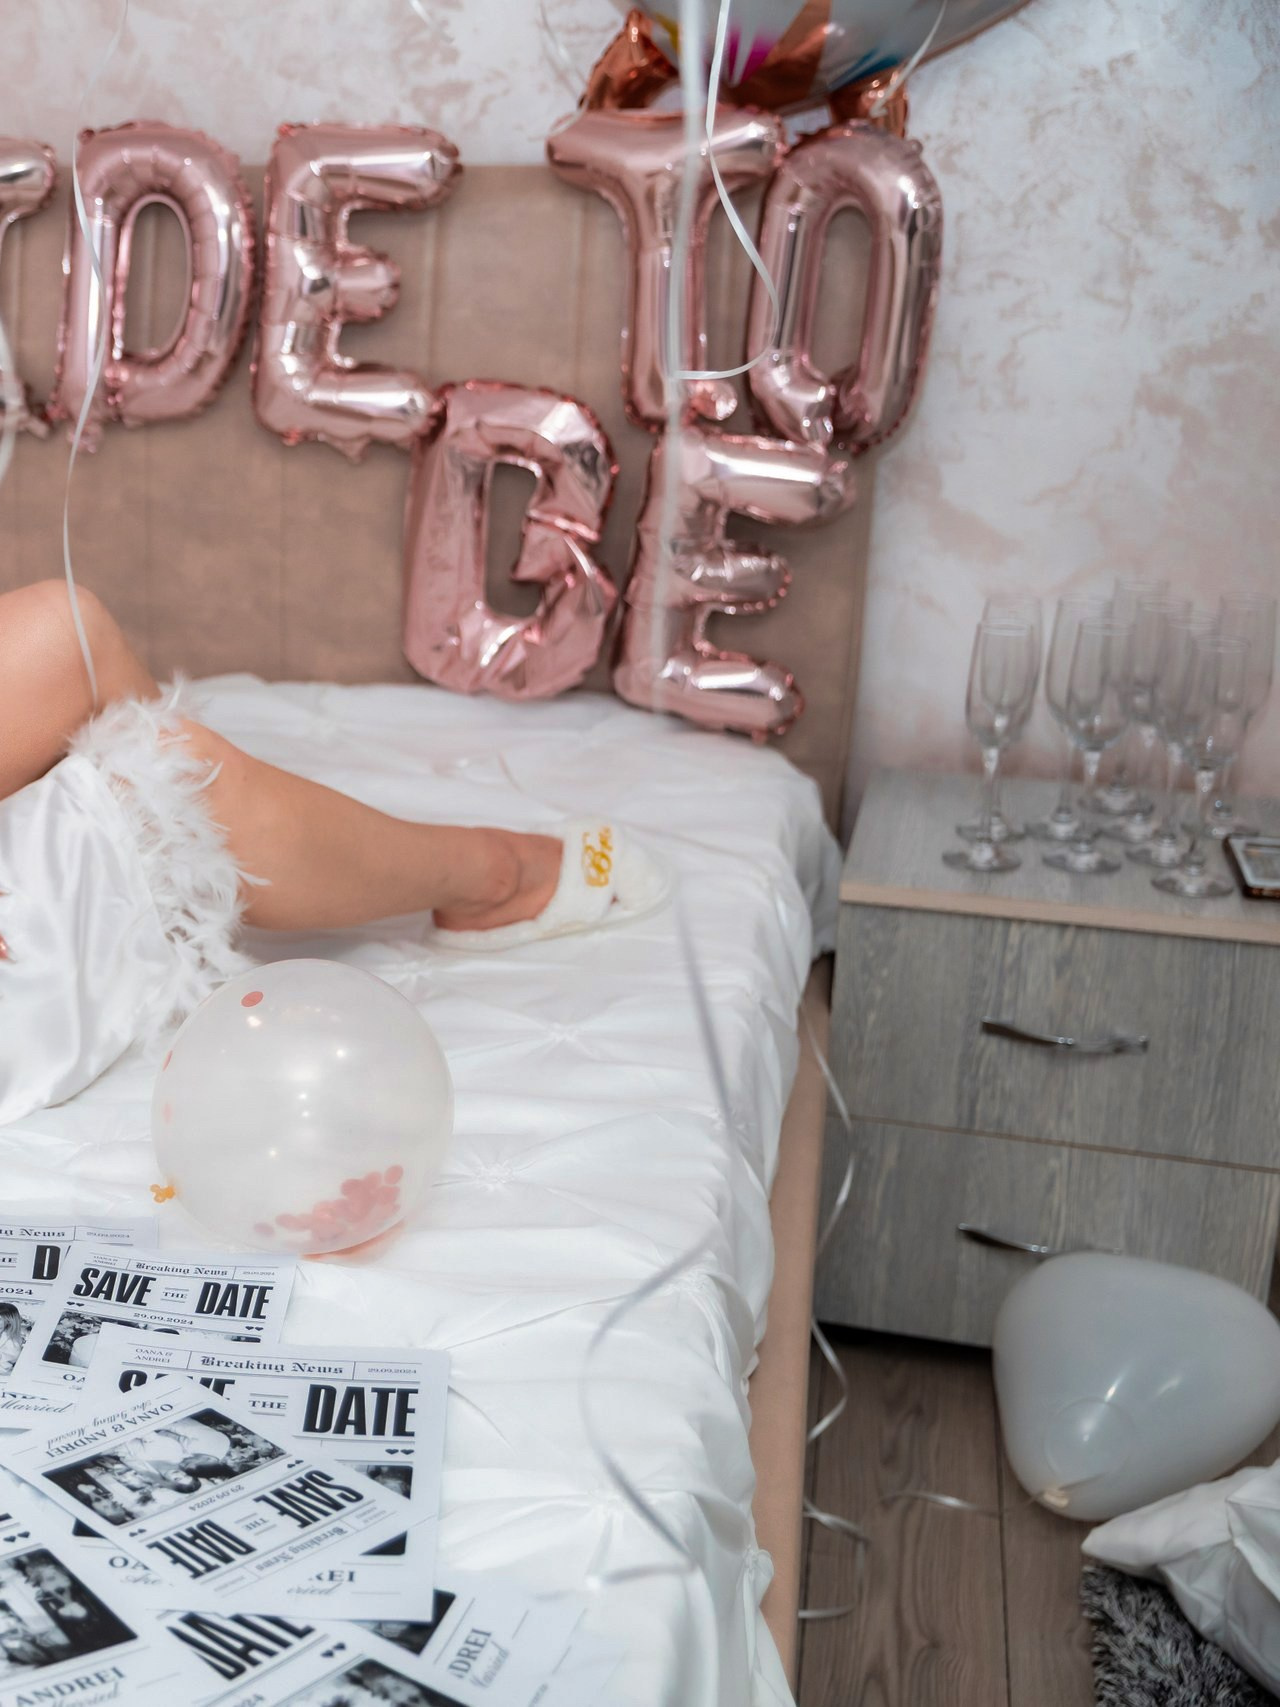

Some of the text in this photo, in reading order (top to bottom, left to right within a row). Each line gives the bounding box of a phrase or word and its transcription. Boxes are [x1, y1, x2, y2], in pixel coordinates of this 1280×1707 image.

[546, 103, 945, 457] TO
[19, 1227, 66, 1238] News
[135, 1262, 228, 1276] Breaking News
[73, 1267, 274, 1319] SAVE THE DATE
[133, 1312, 194, 1326] 29.09.2024
[200, 1355, 344, 1374] Breaking News
[126, 1403, 173, 1425] OANA
[249, 1383, 419, 1437] THE DATE
[45, 1430, 107, 1458] ANDREI
[146, 1470, 364, 1580] SAVE THE DATE
[15, 1666, 126, 1707] ANDREI
